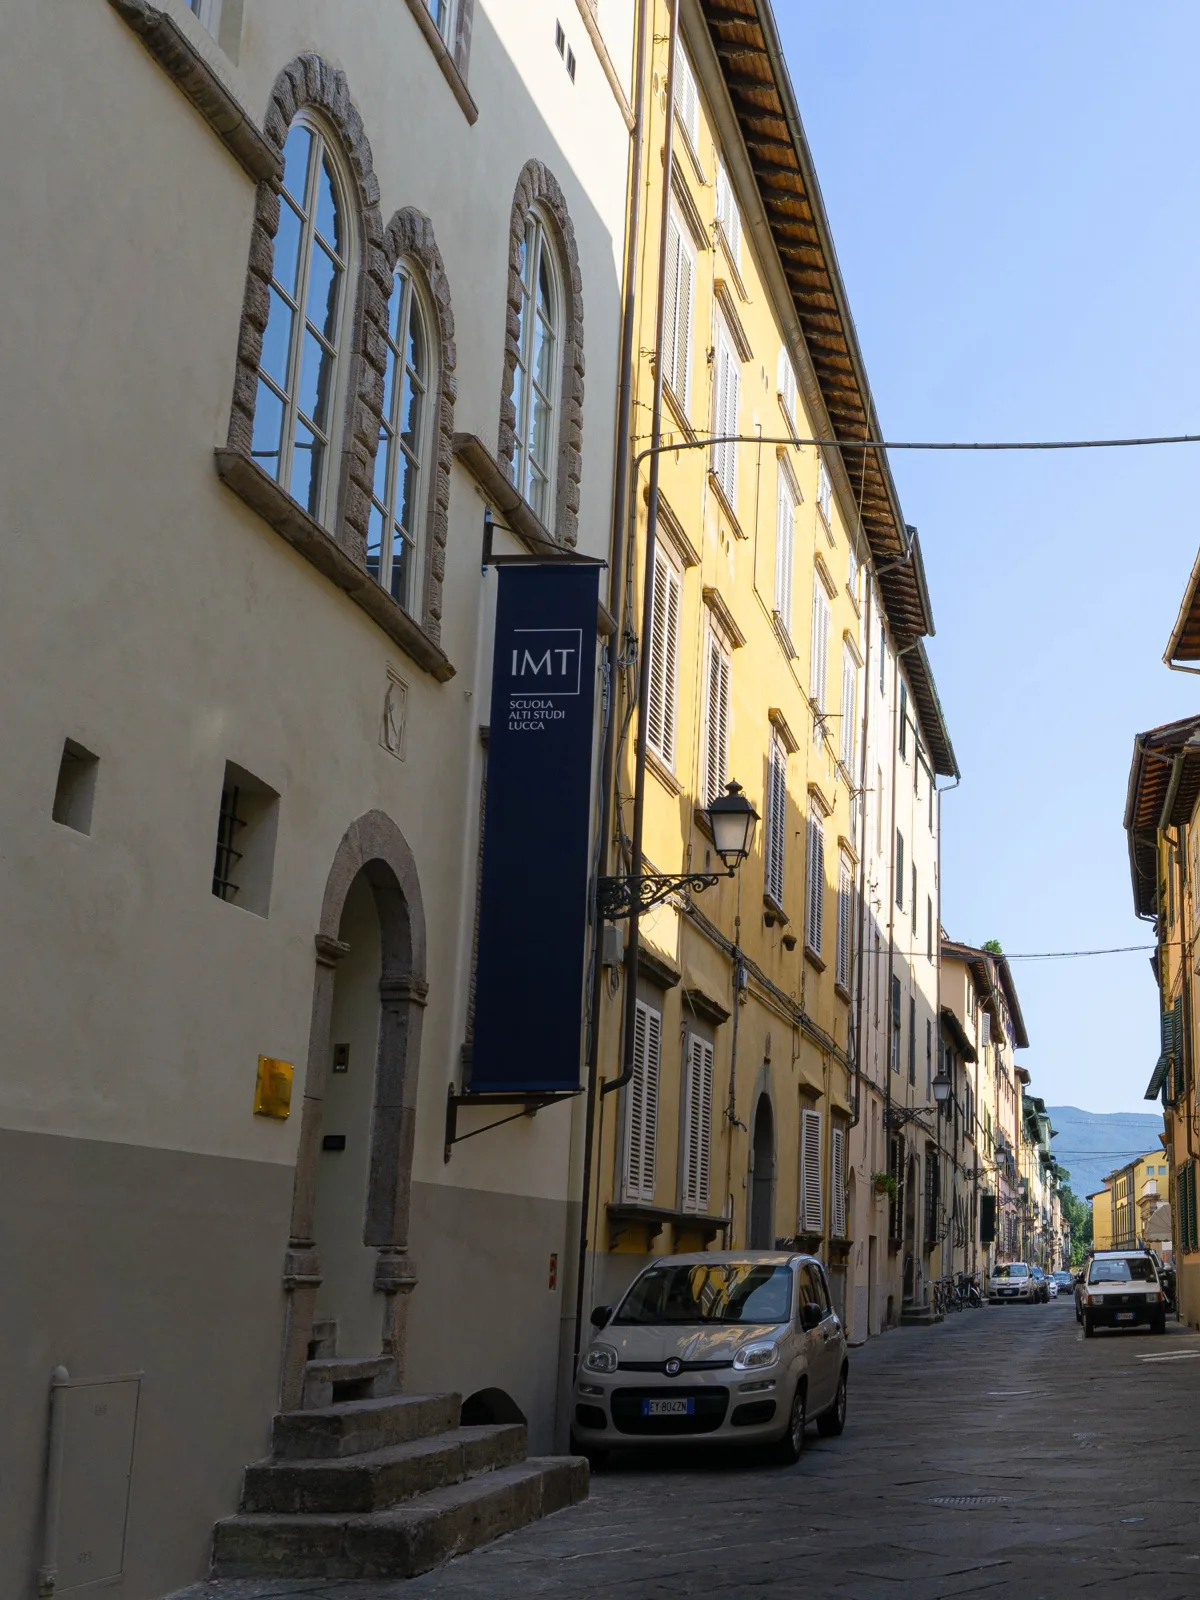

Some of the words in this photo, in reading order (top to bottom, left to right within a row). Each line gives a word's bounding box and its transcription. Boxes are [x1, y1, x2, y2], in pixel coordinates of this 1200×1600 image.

[511, 649, 575, 675] IMT
[510, 700, 553, 709] SCUOLA
[509, 711, 531, 719] ALTI
[533, 710, 565, 719] STUDI
[509, 721, 545, 730] LUCCA
